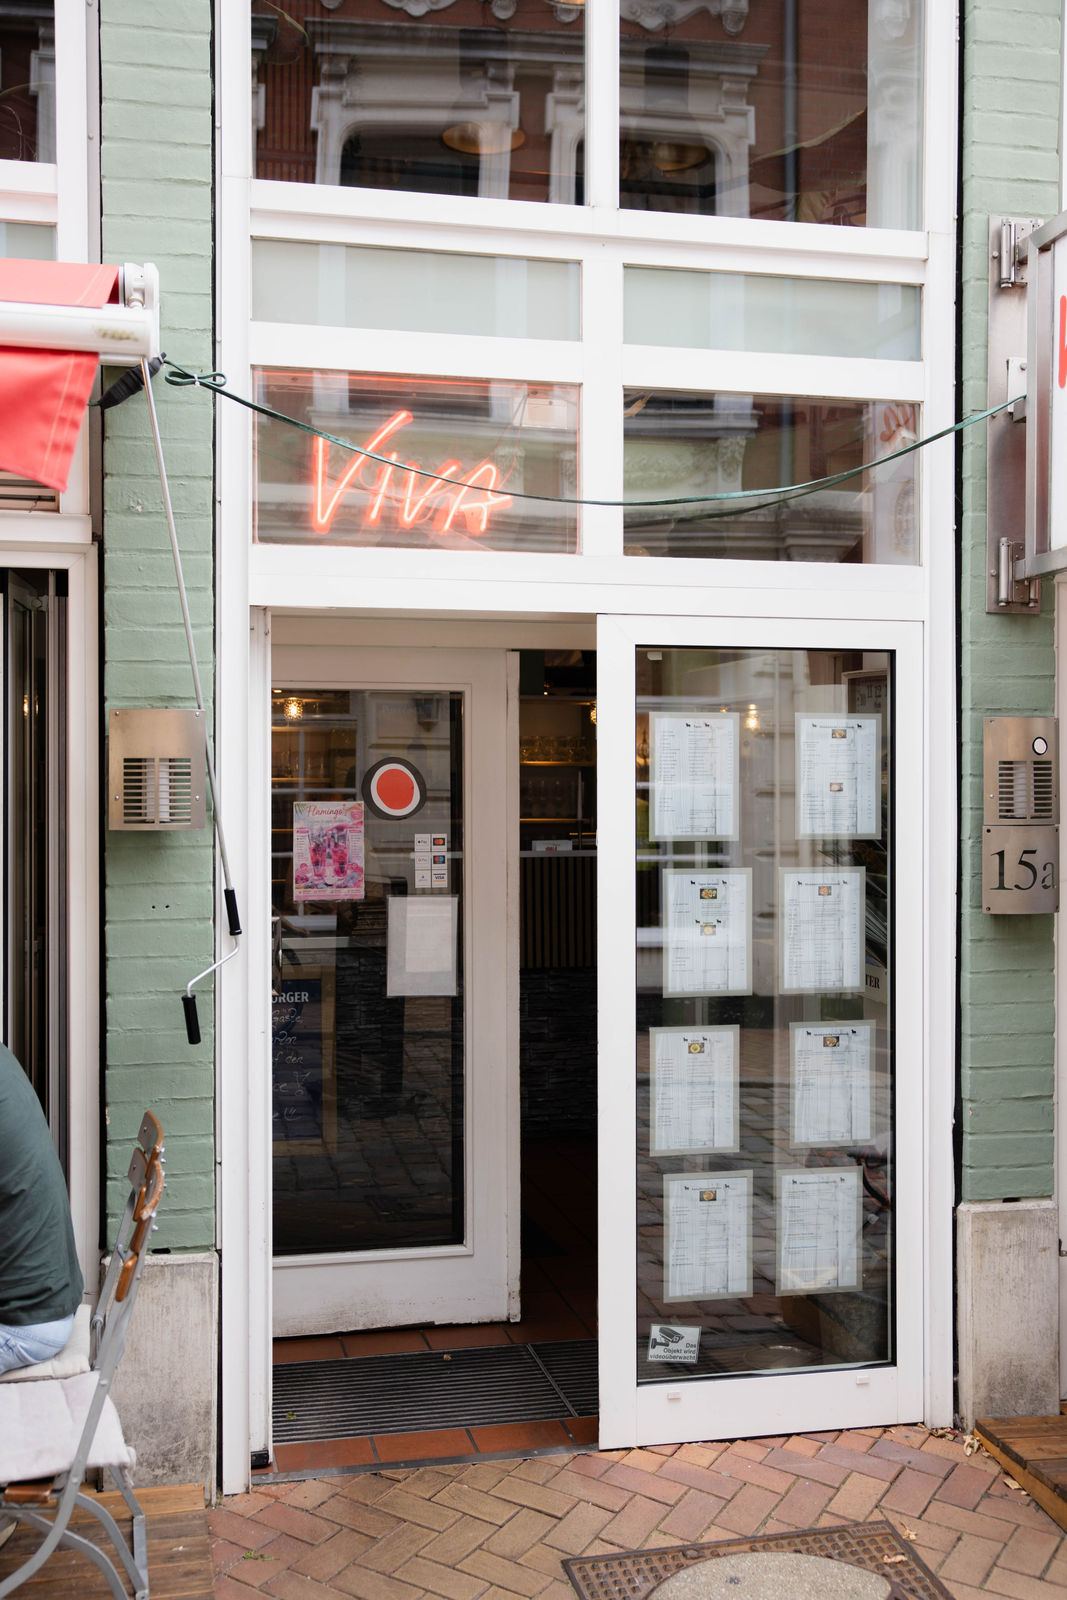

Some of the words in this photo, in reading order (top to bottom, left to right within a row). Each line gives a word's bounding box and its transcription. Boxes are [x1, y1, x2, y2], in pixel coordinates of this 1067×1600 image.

[306, 804, 343, 818] Flamingo
[989, 849, 1056, 891] 15a
[865, 973, 880, 989] TER
